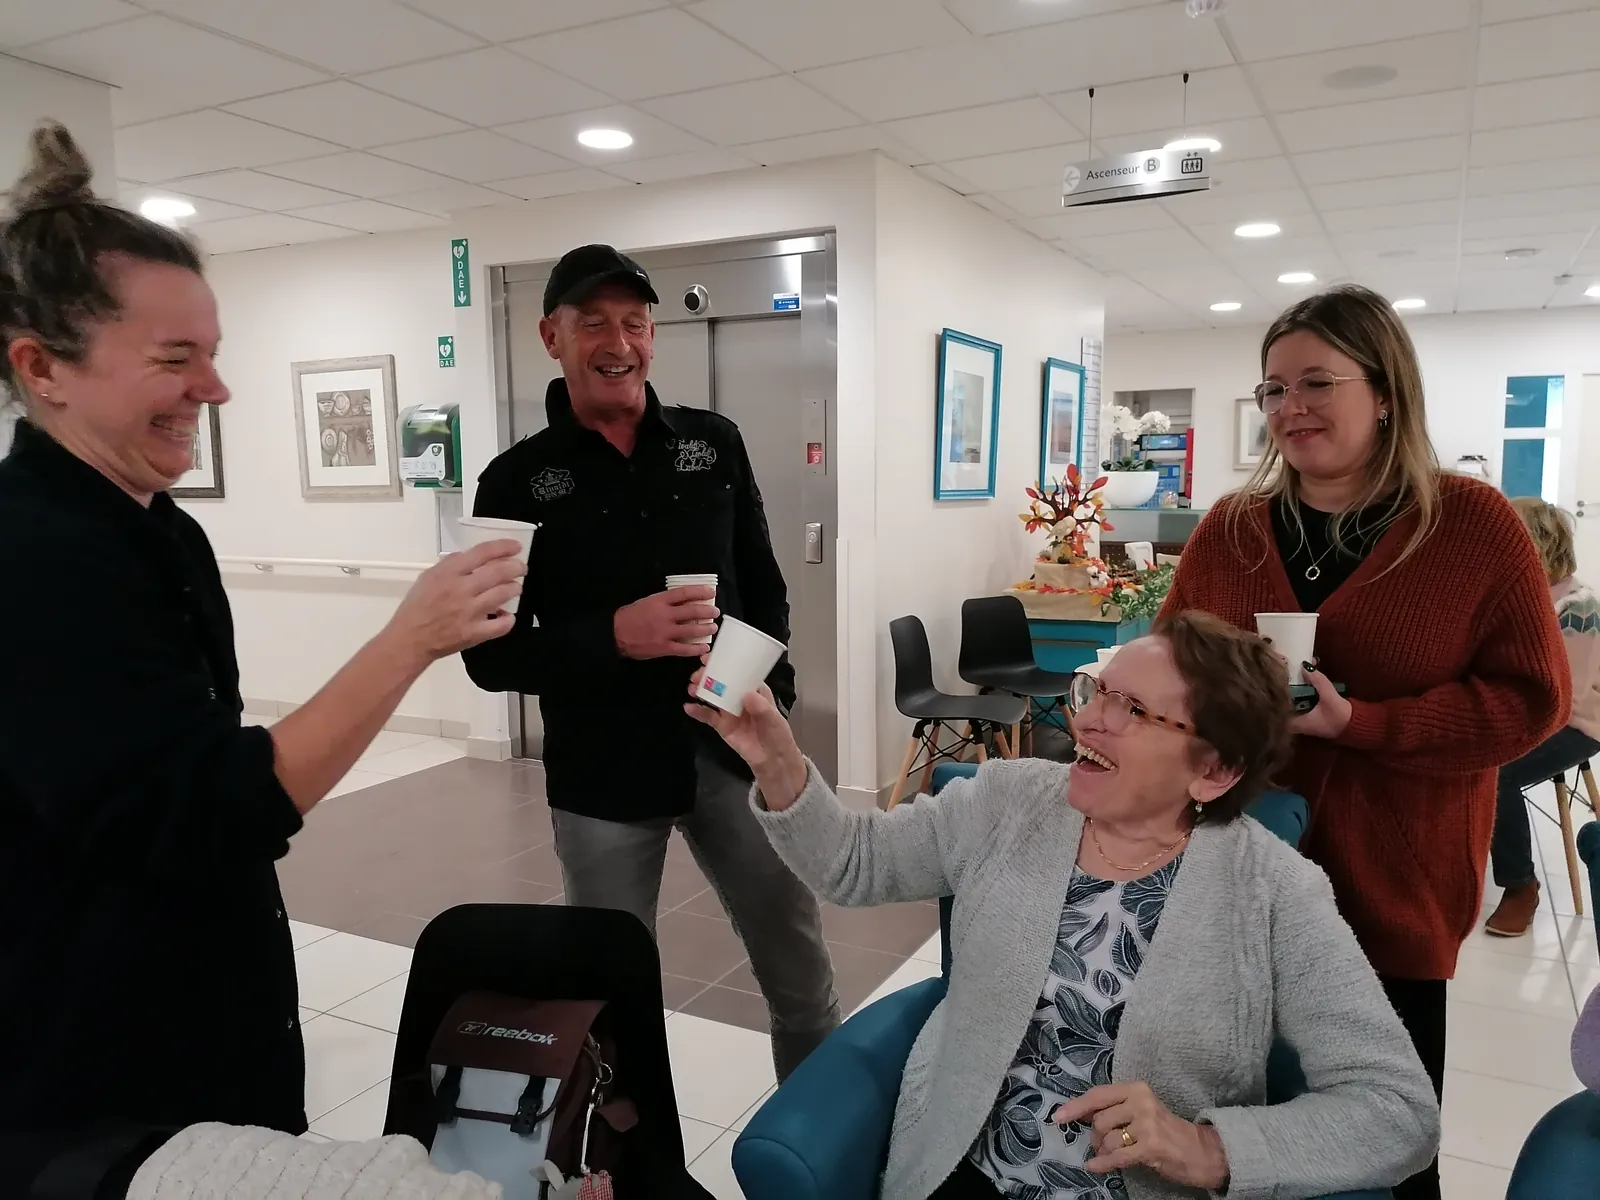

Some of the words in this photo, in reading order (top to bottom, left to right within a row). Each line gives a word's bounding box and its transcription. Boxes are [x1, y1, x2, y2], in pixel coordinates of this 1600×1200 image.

[1086, 164, 1140, 180] Ascenseur
[1146, 159, 1157, 172] B
[457, 260, 465, 288] DAE
[483, 1026, 558, 1045] reebok
